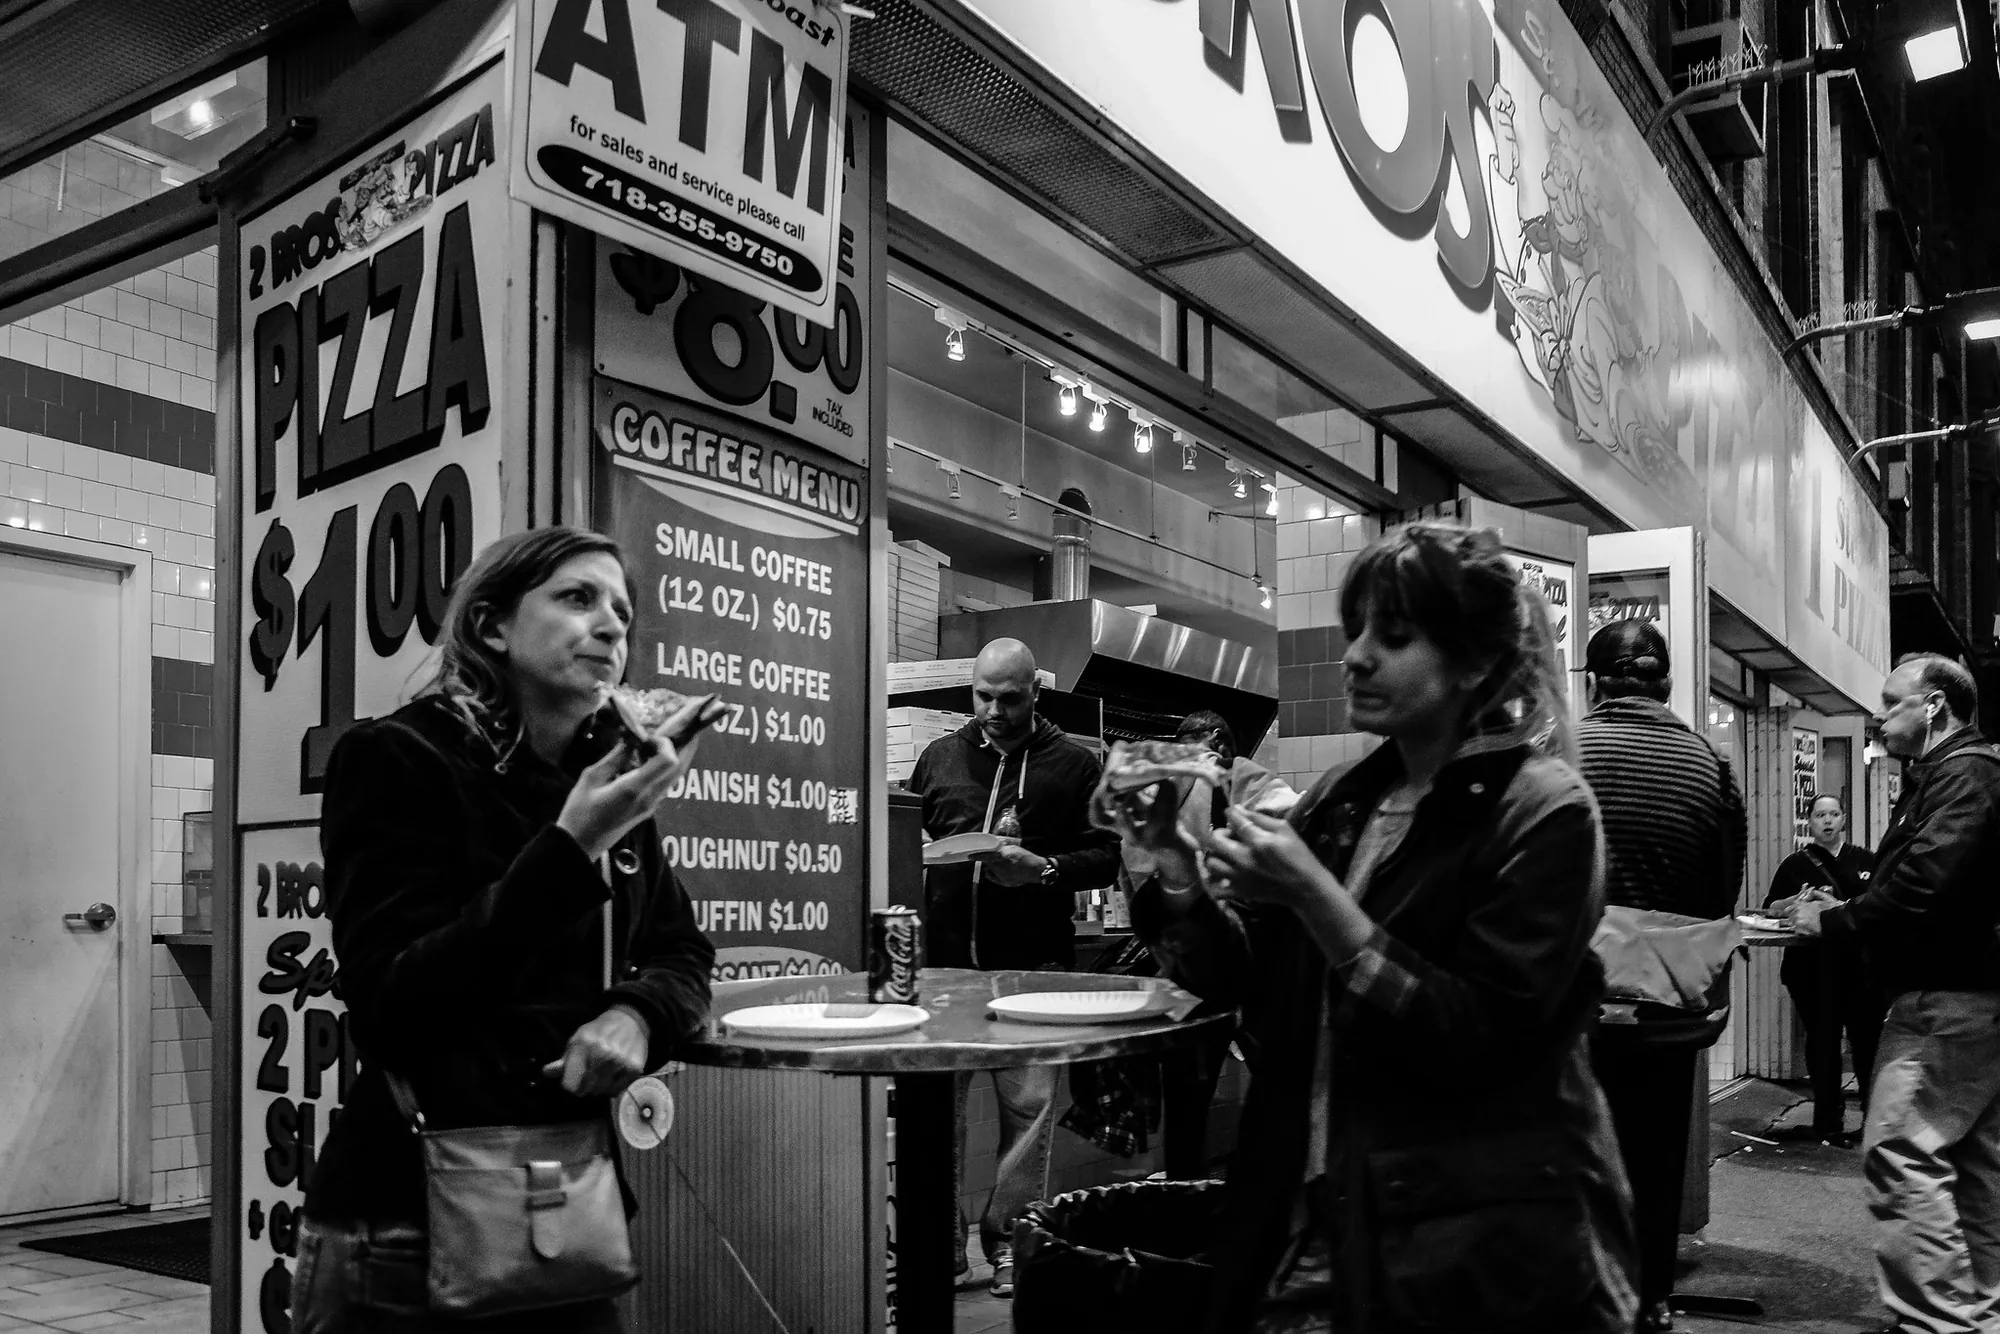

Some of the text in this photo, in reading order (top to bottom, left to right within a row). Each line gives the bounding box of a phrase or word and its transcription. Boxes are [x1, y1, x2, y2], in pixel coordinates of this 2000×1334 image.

[535, 0, 832, 217] ATM
[249, 245, 266, 301] 2
[404, 102, 495, 200] PIZZA
[570, 115, 805, 242] for sales and service please call
[581, 165, 794, 276] 718-355-9750
[254, 200, 492, 515] PIZZA
[812, 406, 854, 438] INCLUDED
[825, 398, 843, 418] TAX
[613, 404, 860, 521] COFFEE MENU
[655, 522, 832, 596] SMALL COFFEE
[658, 574, 832, 640] (12 OZ.) $0.75
[657, 642, 831, 702] LARGE COFFEE
[765, 707, 826, 746] $1.00
[766, 774, 827, 811] $1.00
[257, 862, 271, 918] 2
[785, 840, 842, 875] $0.50
[768, 898, 829, 934] $1.00
[257, 1003, 289, 1094] 2
